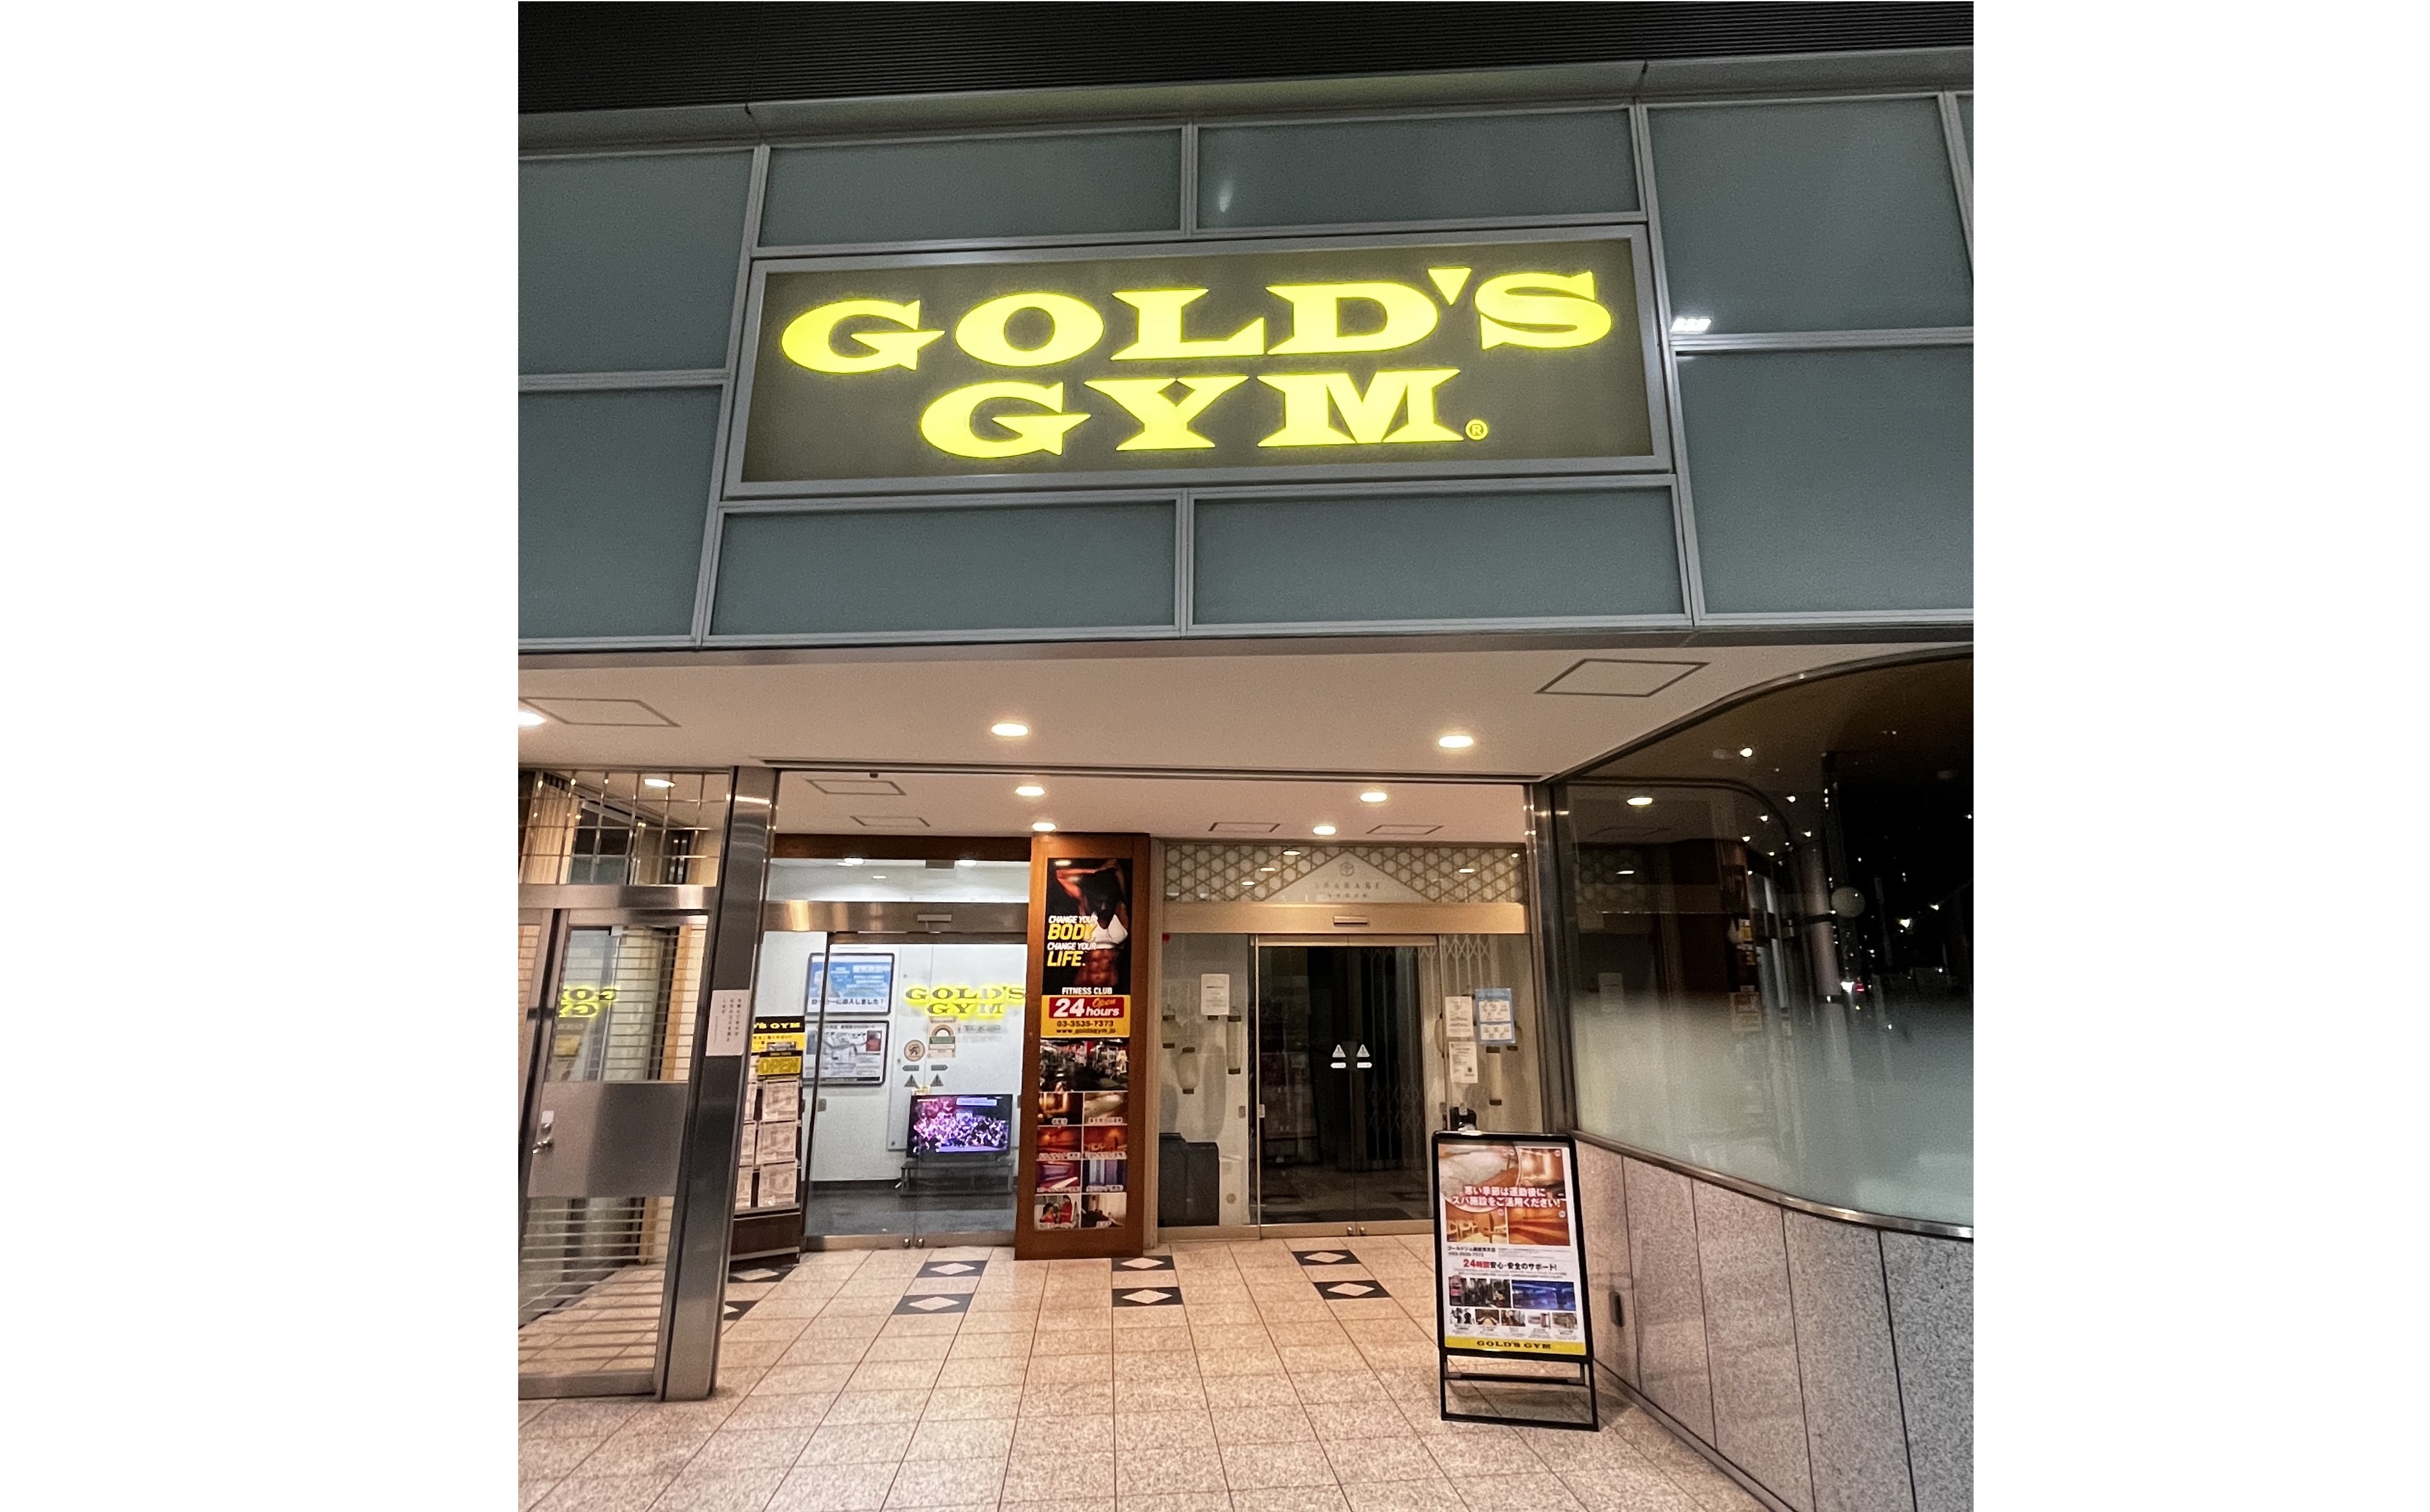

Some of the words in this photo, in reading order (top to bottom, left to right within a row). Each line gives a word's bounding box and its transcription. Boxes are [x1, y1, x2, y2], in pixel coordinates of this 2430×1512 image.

[780, 266, 1612, 374] GOLD'S
[920, 367, 1464, 458] GYM
[1048, 915, 1078, 924] CHANGE
[1078, 915, 1098, 924] YOUR
[1047, 942, 1077, 951] CHANGE
[1077, 942, 1097, 951] YOUR
[1047, 950, 1086, 967] LIFE.
[905, 986, 1026, 1001] GOLD'S
[1061, 987, 1092, 995] FITNESS
[1093, 987, 1113, 995] CLUB
[926, 1002, 1004, 1014] GYM
[1053, 998, 1085, 1018] 24
[1092, 997, 1116, 1008] Open
[1085, 1006, 1120, 1017] hours
[759, 1058, 799, 1074] OPEN
[1476, 1340, 1521, 1348] GOLD'S
